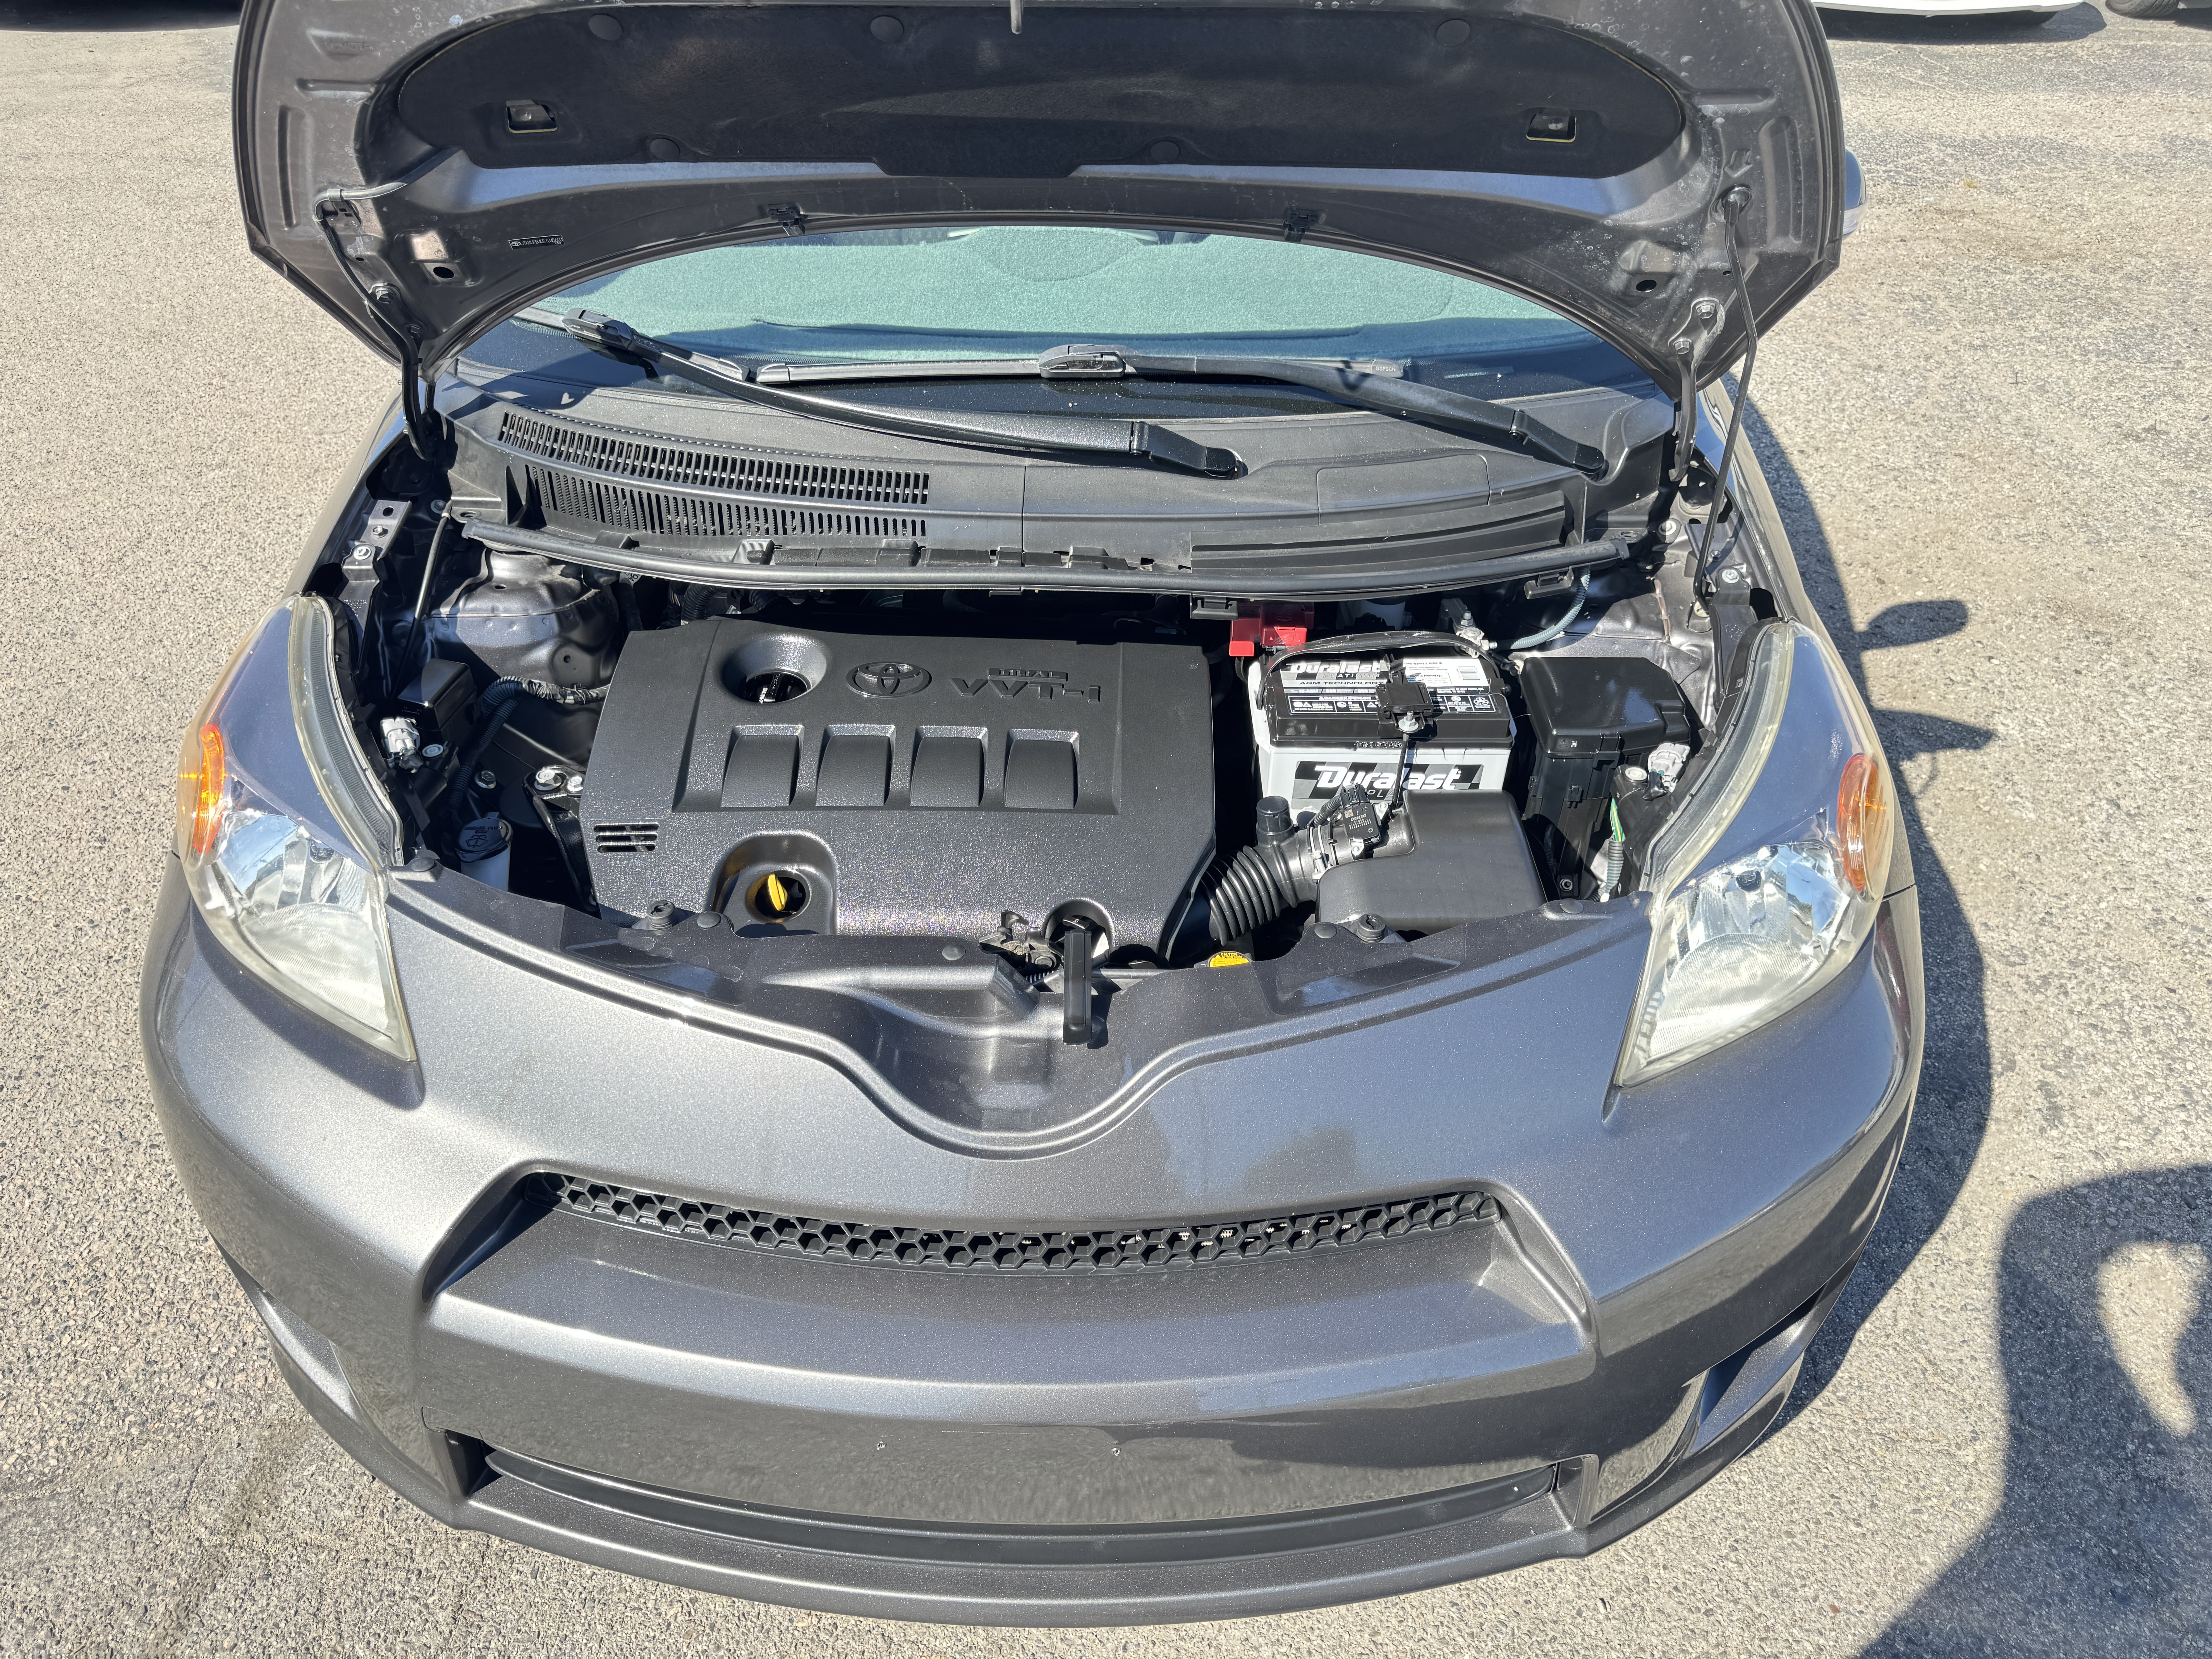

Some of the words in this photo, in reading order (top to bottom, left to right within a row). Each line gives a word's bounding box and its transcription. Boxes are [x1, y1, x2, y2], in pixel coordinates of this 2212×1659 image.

[1286, 661, 1381, 673] Duralast
[999, 669, 1060, 678] DUAL
[1350, 813, 1367, 821] DENSO
